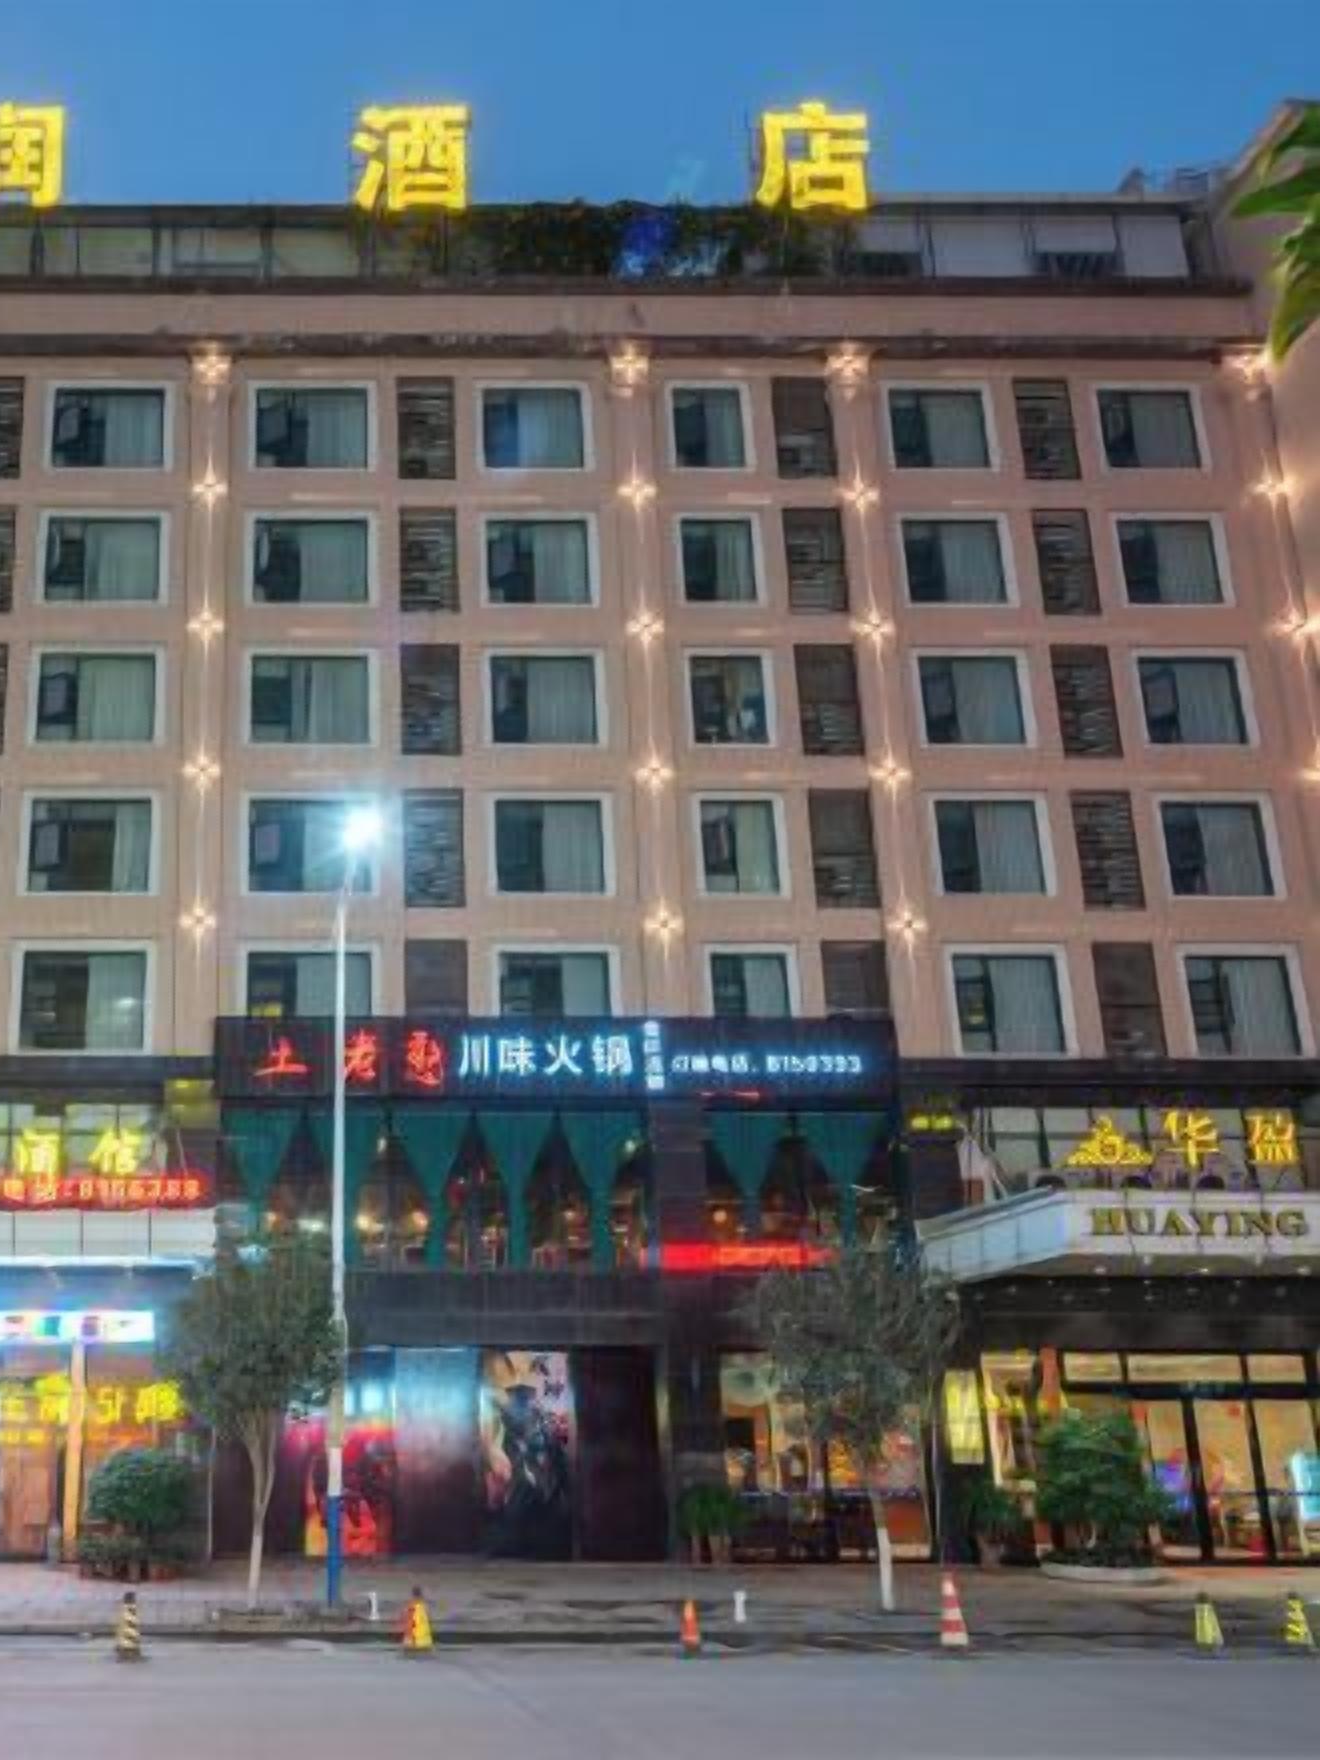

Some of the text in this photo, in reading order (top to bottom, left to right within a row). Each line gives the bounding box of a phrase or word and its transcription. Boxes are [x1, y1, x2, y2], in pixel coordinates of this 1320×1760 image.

[459, 1033, 634, 1077] 川味火锅
[1091, 1207, 1309, 1237] HUAYING
